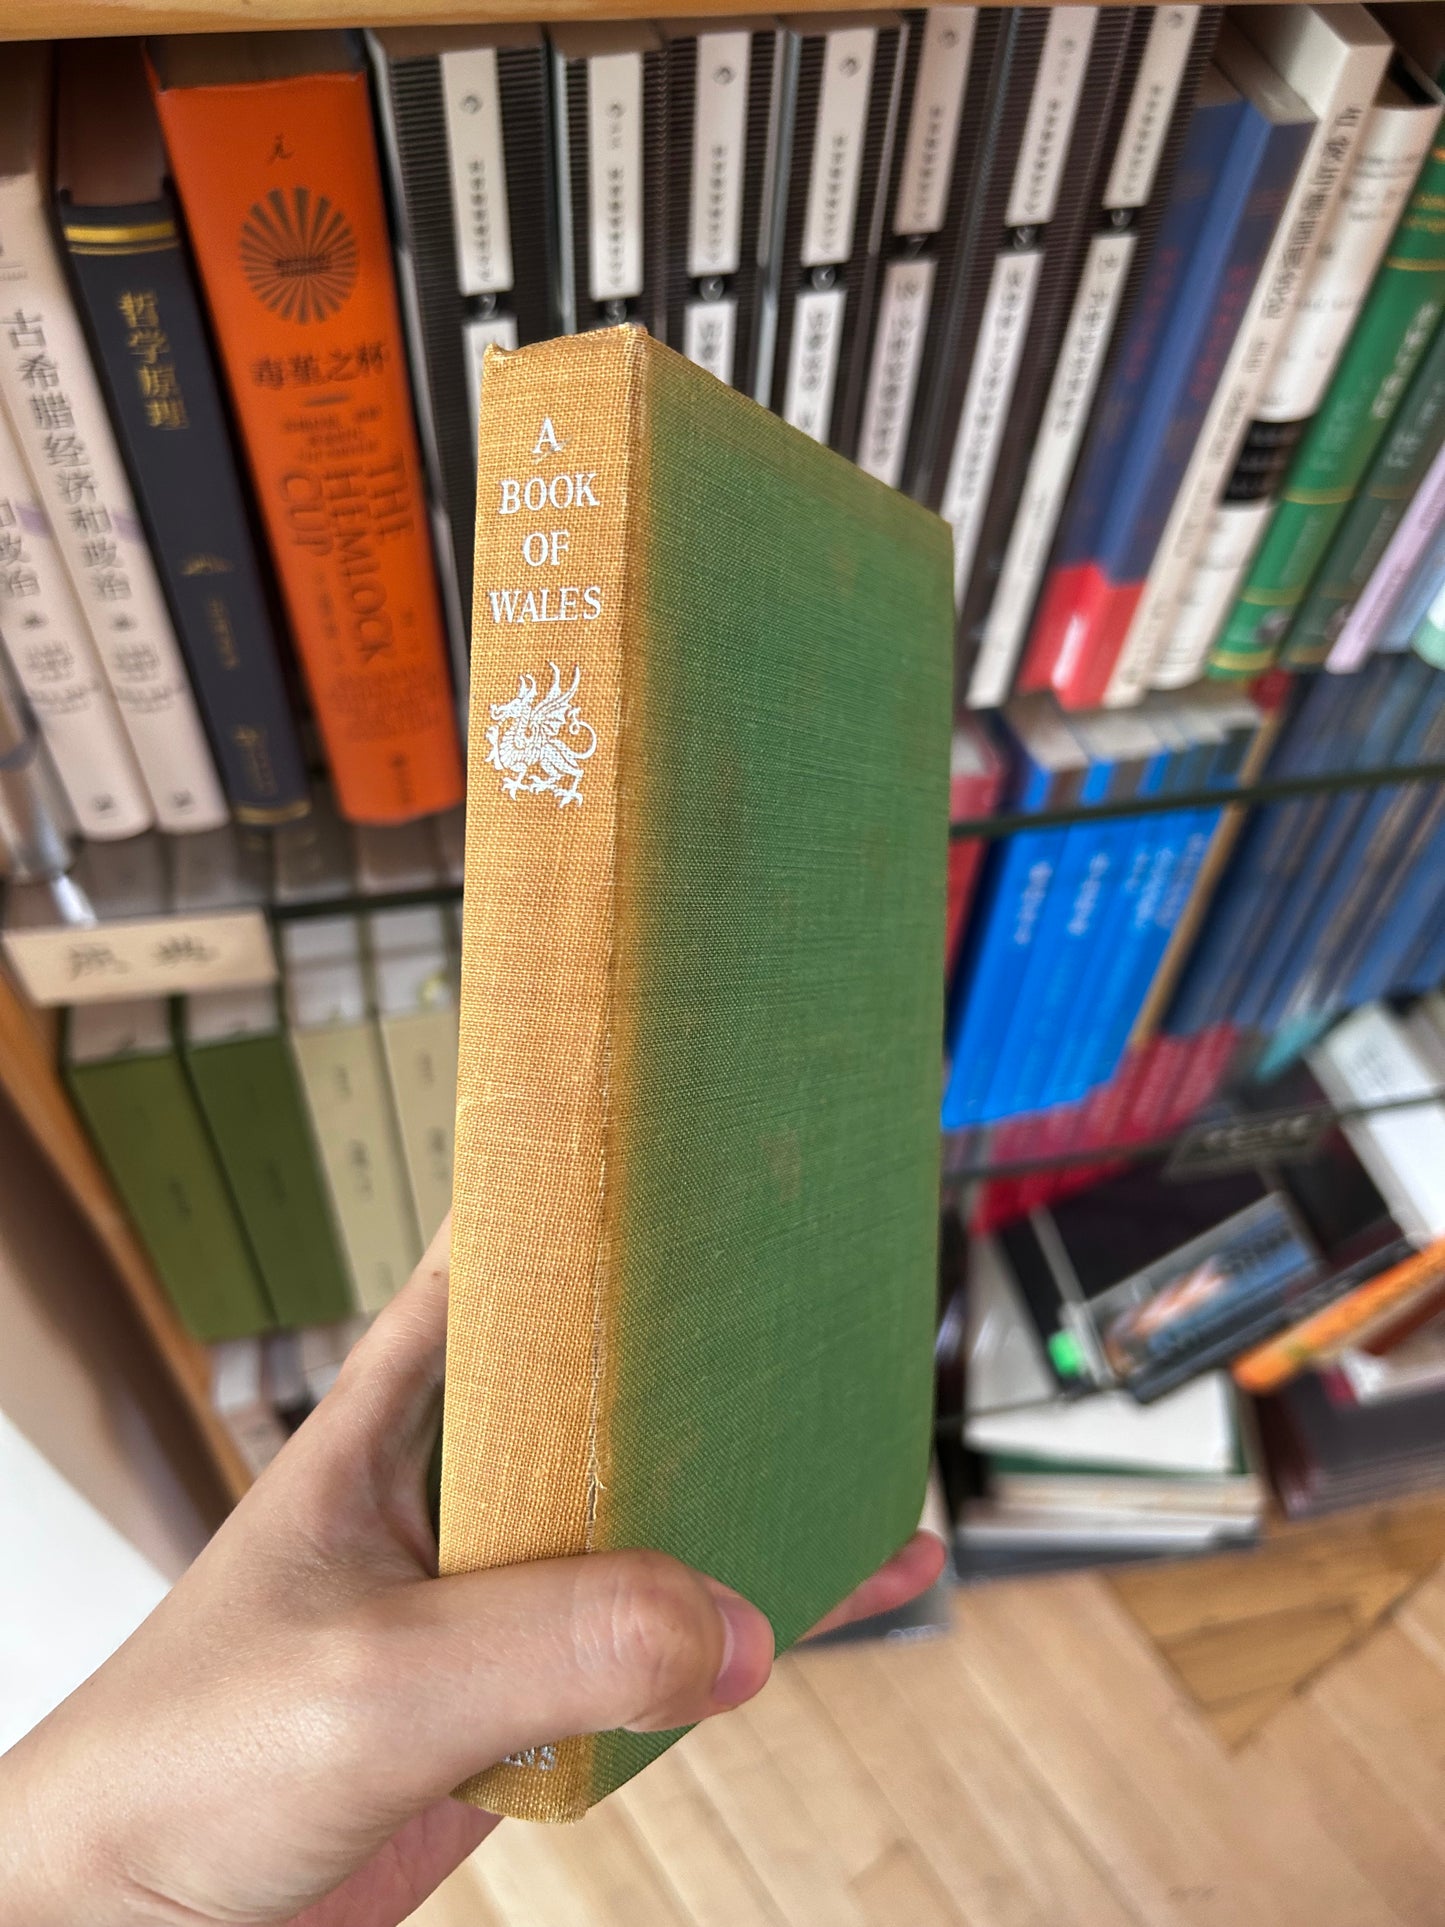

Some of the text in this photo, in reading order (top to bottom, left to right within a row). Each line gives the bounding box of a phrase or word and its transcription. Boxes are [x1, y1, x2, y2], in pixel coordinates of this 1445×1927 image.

[2, 308, 131, 601] 古希腊经济和政治
[532, 417, 562, 454] A
[281, 468, 335, 556] CUP
[499, 473, 600, 515] BOOK
[322, 464, 395, 665] HEMLOCK
[522, 530, 571, 567] OF
[488, 585, 602, 624] WALES
